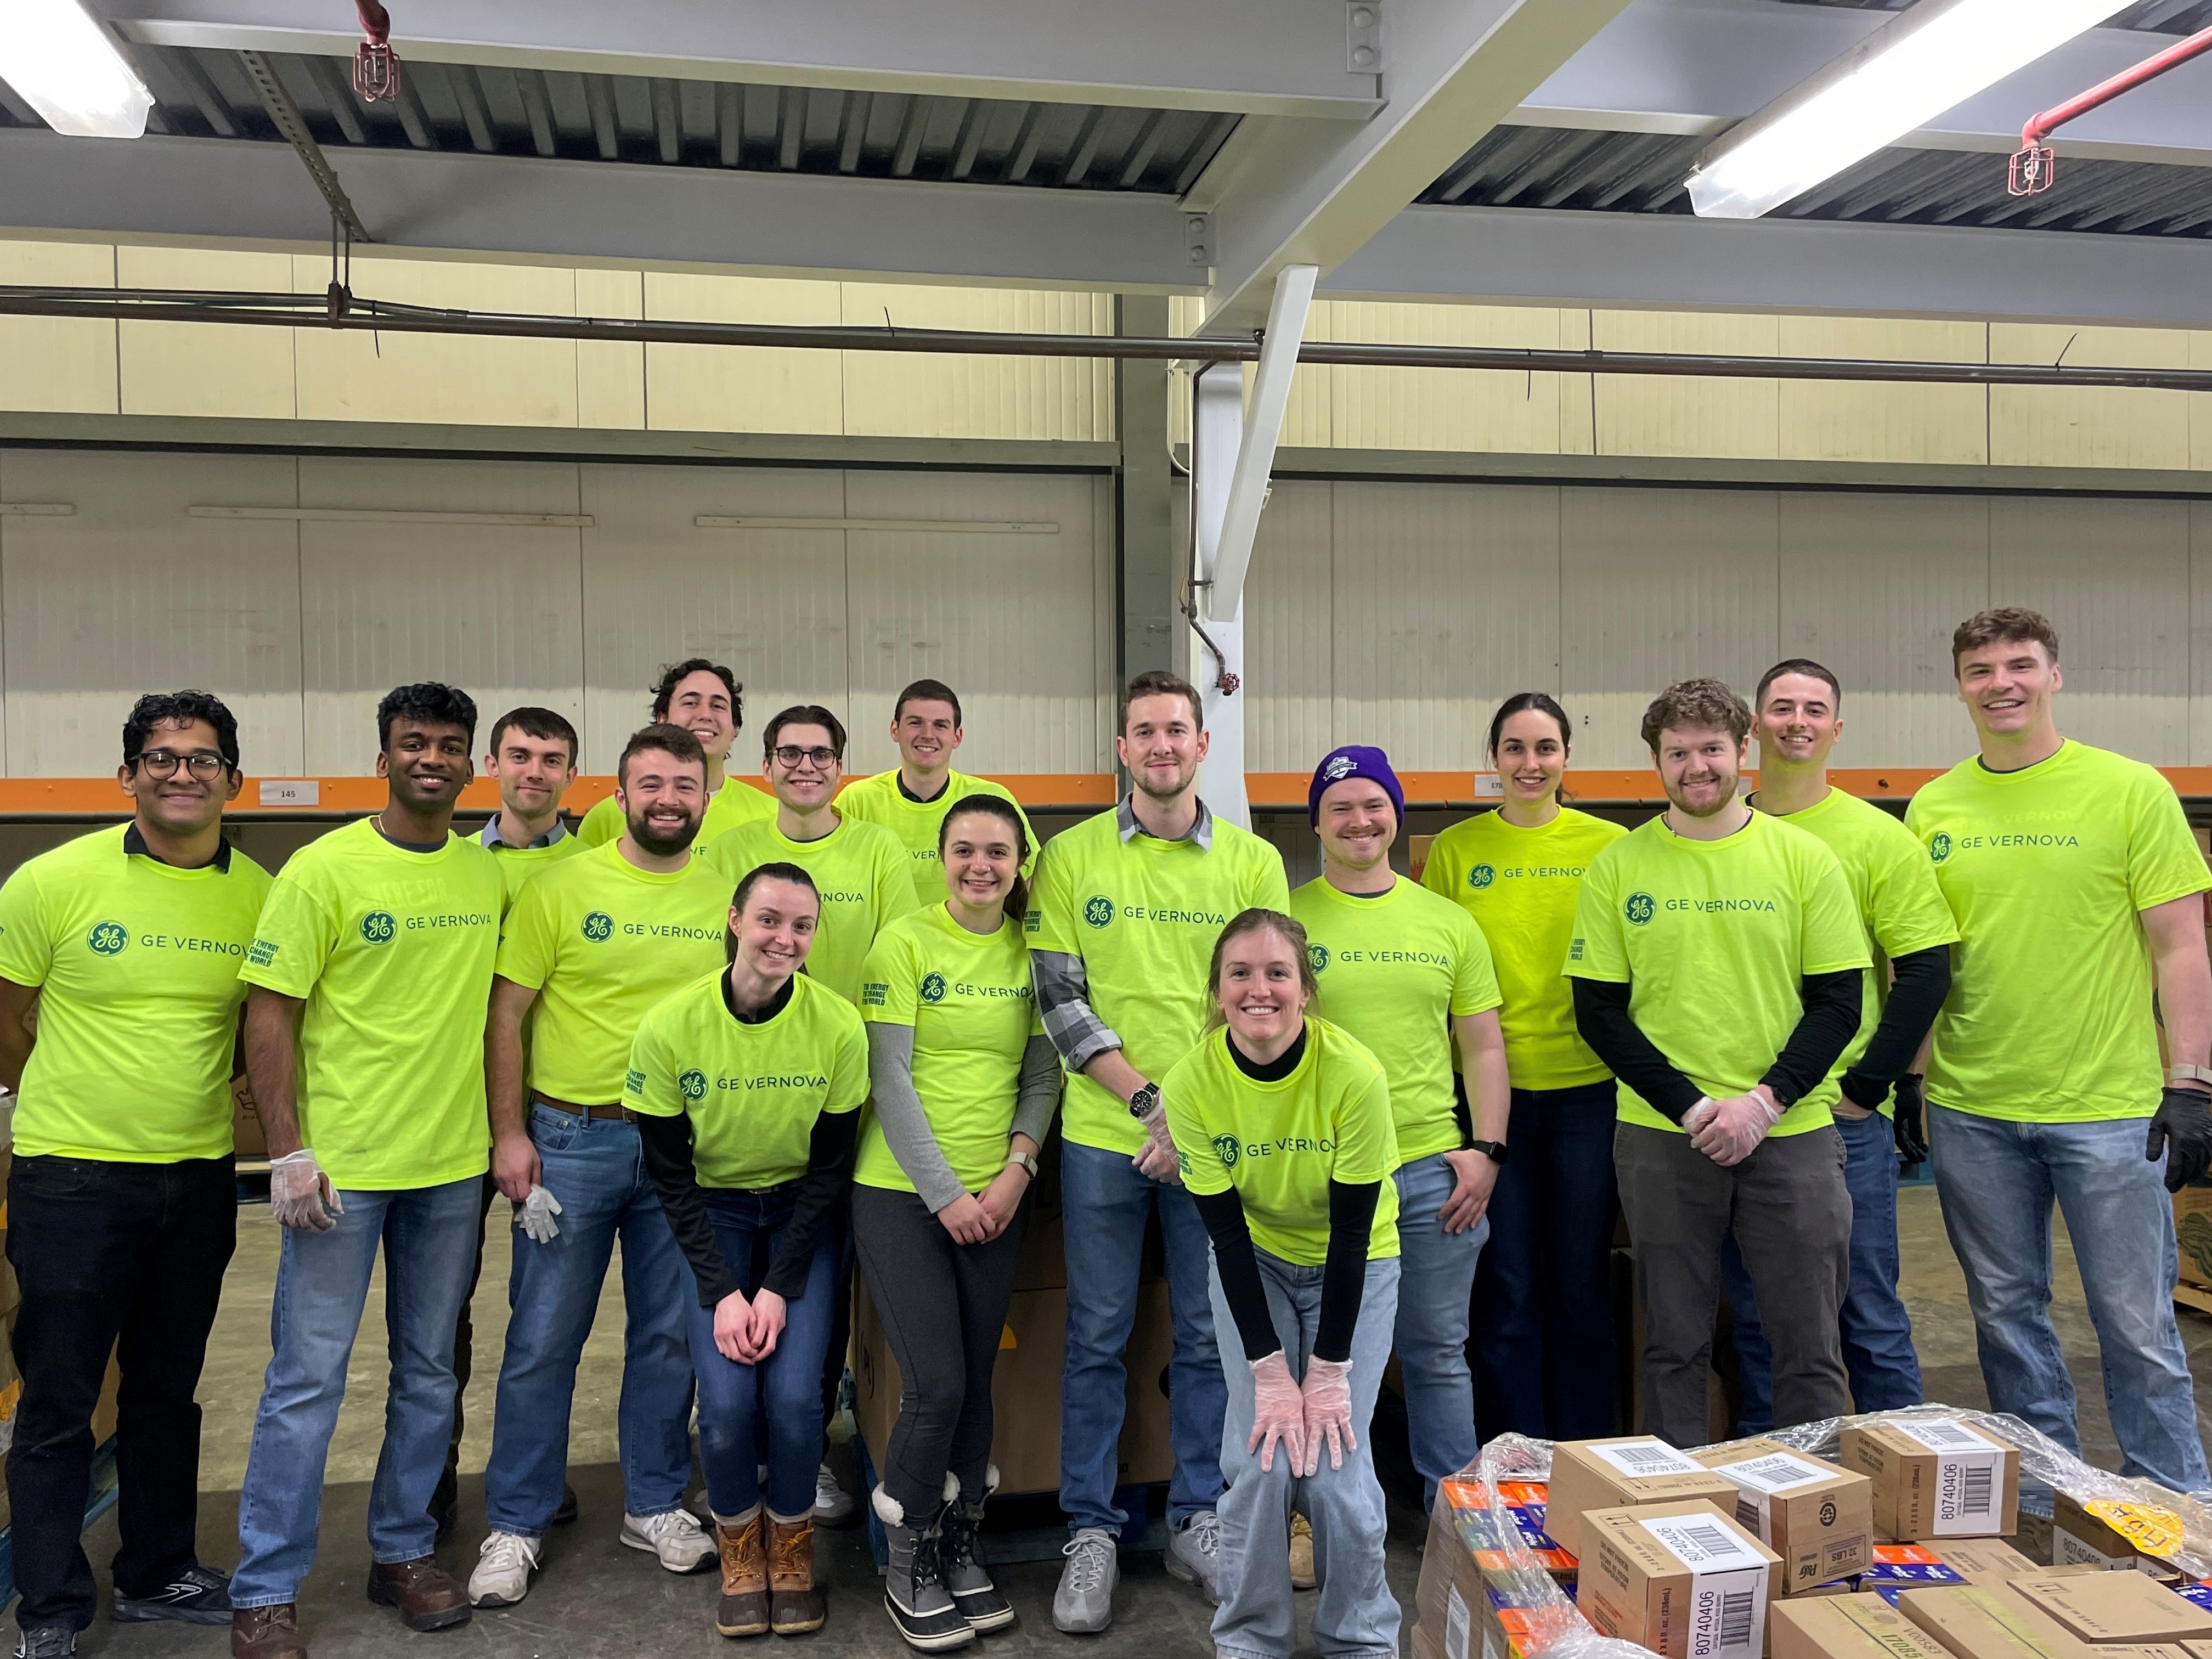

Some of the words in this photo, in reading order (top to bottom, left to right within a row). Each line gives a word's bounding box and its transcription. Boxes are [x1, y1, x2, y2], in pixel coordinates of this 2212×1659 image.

[1961, 836, 1982, 849] GE
[1988, 834, 2079, 848] VERNOVA
[1504, 867, 1524, 878] GE
[1528, 867, 1587, 878] VERNO
[820, 891, 865, 903] NOVA
[1666, 899, 1689, 910] GE
[1694, 899, 1776, 913] VERNOVA
[406, 917, 425, 929] GE
[428, 914, 492, 928] VERNOVA
[1124, 906, 1145, 919] GE
[1147, 909, 1226, 926] VERNOVA
[623, 923, 645, 935] GE
[650, 925, 722, 942] VERNOVA
[141, 934, 167, 947] GE
[256, 940, 279, 953] ENERGY
[250, 946, 275, 960] CHANGE
[1340, 950, 1362, 962] GE
[1368, 951, 1449, 968] VERNOVA
[250, 955, 272, 967] WORLD
[955, 983, 974, 996] GE
[717, 1078, 740, 1090] GE
[744, 1075, 828, 1090] VERNOVA
[1246, 1143, 1272, 1157] GE
[1940, 1463, 1957, 1520] 80740406
[1656, 1527, 1704, 1562] 80740406
[1848, 1547, 1858, 1556] 32
[1606, 1546, 1615, 1558] NOT
[1831, 1550, 1847, 1562] LBS
[1799, 1564, 1817, 1580] P&G
[1661, 1588, 1672, 1616] (236mL)
[1695, 1591, 1714, 1656] 80740406
[1881, 1634, 1927, 1659] 17085
